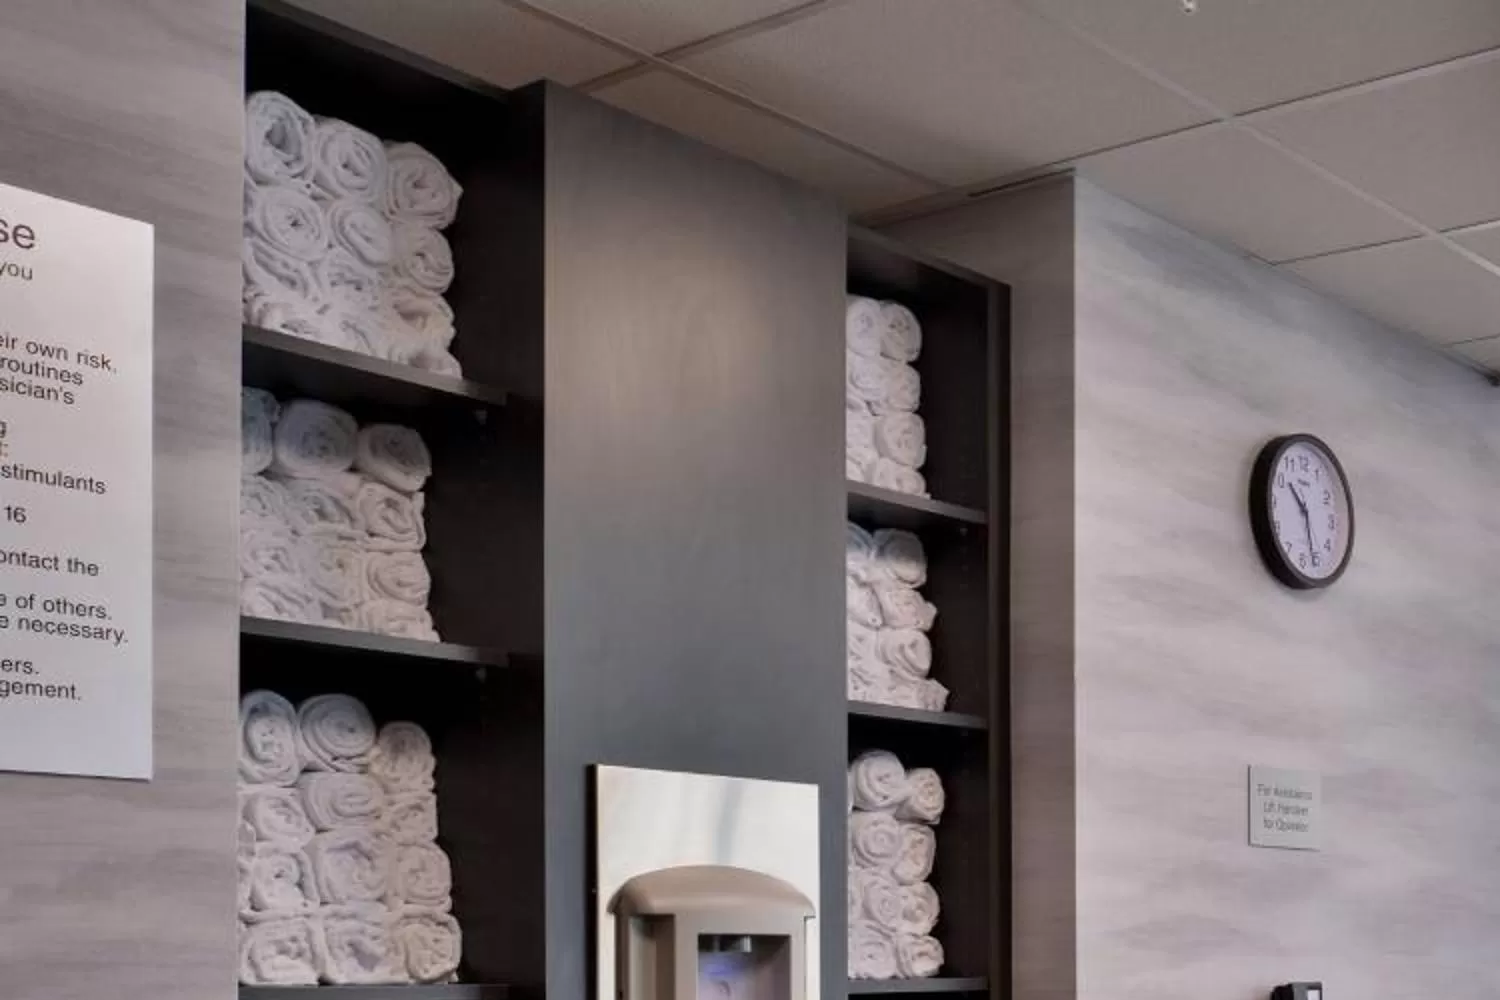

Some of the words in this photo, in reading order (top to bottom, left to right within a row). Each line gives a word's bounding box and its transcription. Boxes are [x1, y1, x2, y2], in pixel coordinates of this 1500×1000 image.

[25, 340, 69, 361] own
[0, 357, 84, 387] routines
[1, 463, 107, 495] stimulants
[4, 504, 27, 523] 16
[66, 556, 99, 577] the
[15, 593, 36, 610] of
[43, 597, 113, 621] others.
[17, 616, 129, 648] necessary.
[1, 658, 40, 675] ers.
[0, 679, 82, 701] gement.
